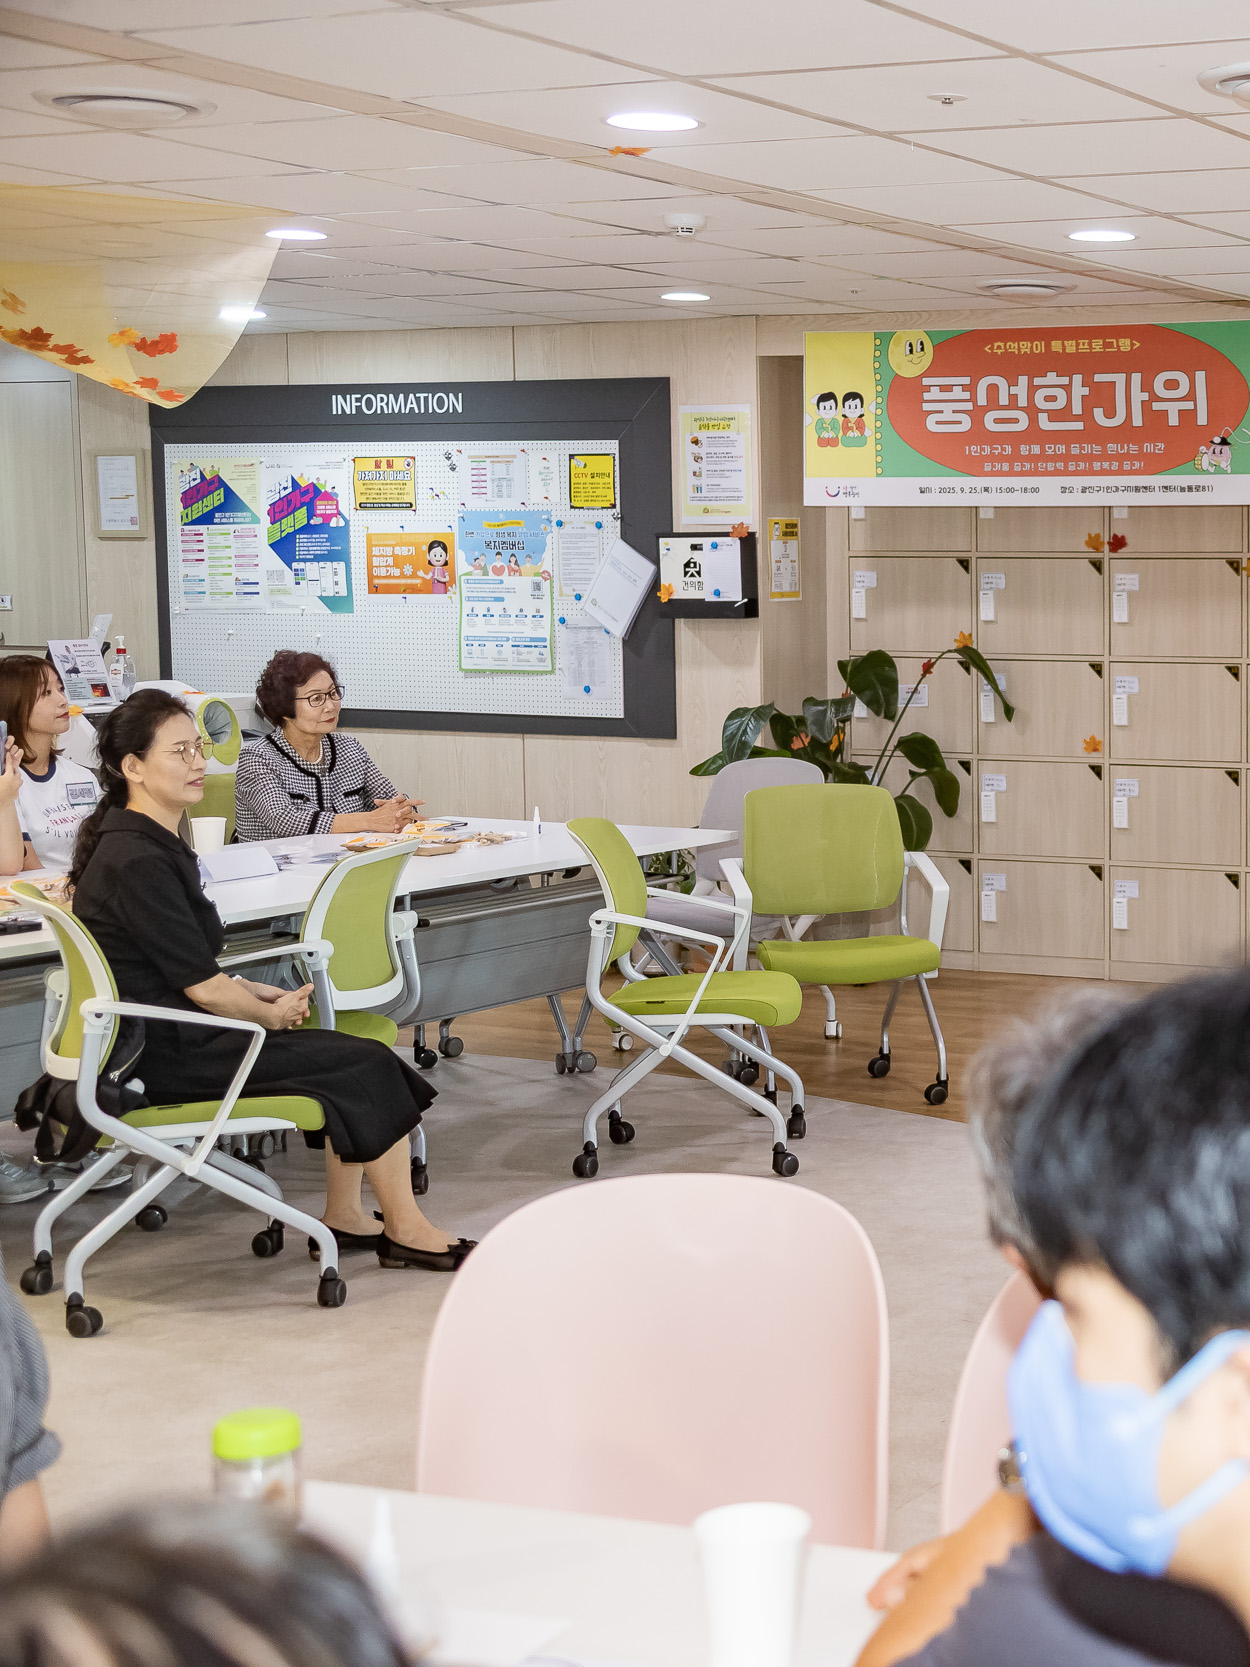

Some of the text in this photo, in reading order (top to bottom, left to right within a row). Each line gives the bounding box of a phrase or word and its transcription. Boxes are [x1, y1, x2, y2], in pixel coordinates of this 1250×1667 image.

[985, 338, 1140, 355] <추석맞이 특별프로그램>
[331, 392, 463, 415] INFORMATION
[921, 370, 1209, 433] 풍성한가위
[964, 442, 1165, 456] 1인가구가 함께 모여 즐기는 신나는 시간
[180, 474, 219, 509] 1인가구
[1060, 486, 1074, 494] 장소
[180, 487, 224, 526] 지원센터
[267, 481, 315, 524] 1인가구
[267, 505, 308, 546] 플랫폼
[484, 540, 525, 551] 복지멤버십
[372, 566, 401, 576] 이용가능
[682, 580, 704, 591] 건의함
